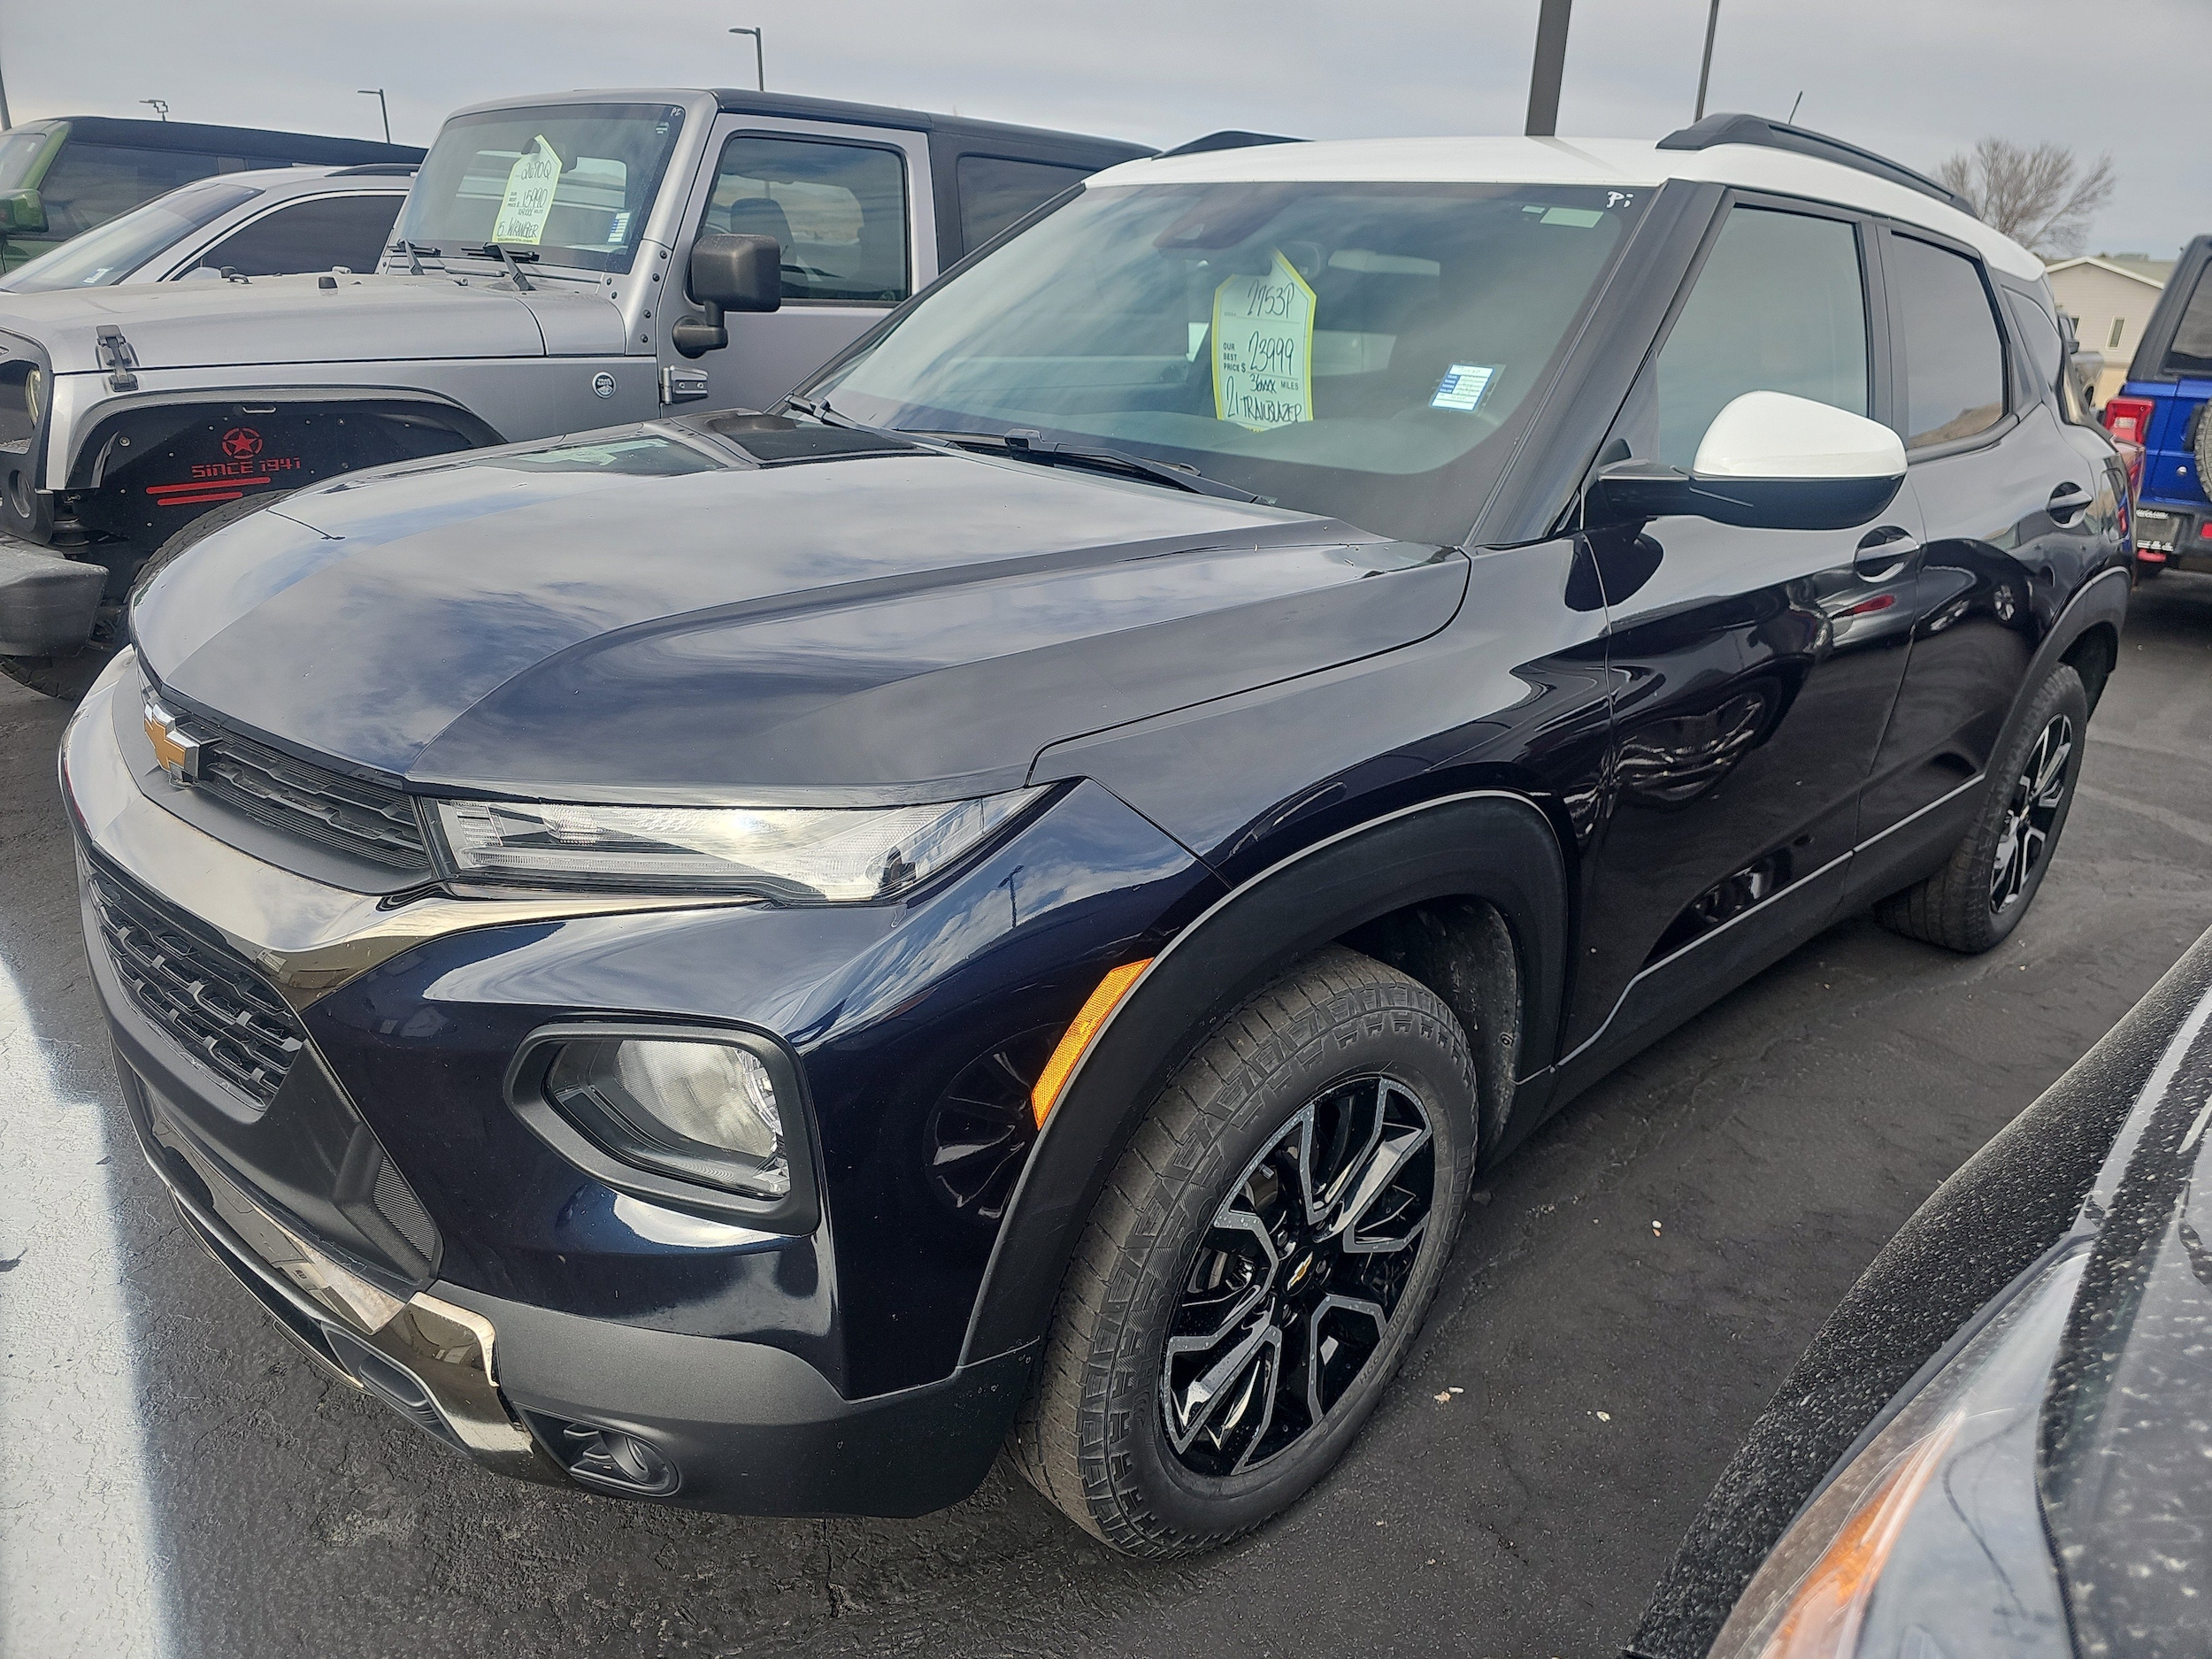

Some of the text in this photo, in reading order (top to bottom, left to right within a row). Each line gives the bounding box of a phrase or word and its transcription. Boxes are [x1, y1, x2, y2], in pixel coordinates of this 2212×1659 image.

[1223, 342, 1235, 350] OUR
[1223, 353, 1237, 362] BEST
[1248, 330, 1294, 375] 23999
[1280, 380, 1299, 391] MILES
[258, 457, 301, 472] 1941
